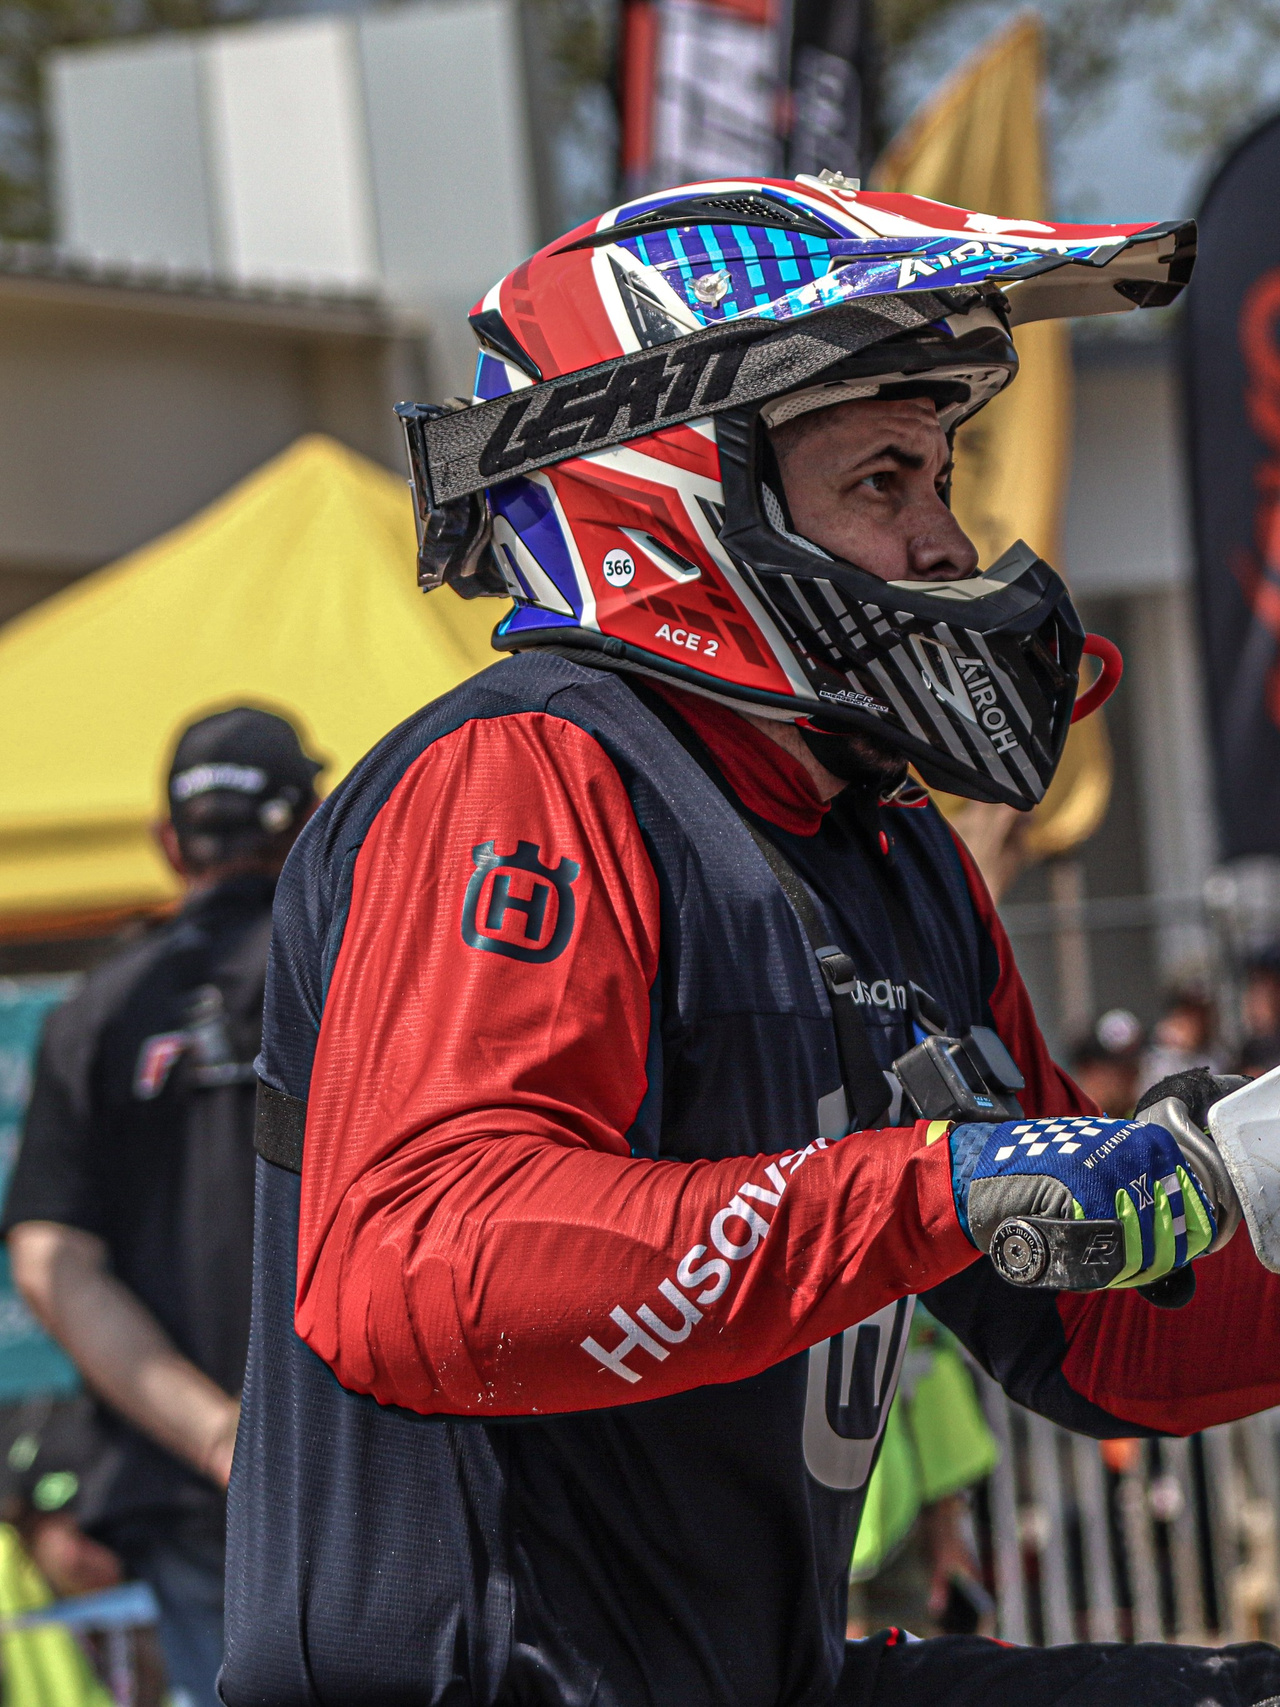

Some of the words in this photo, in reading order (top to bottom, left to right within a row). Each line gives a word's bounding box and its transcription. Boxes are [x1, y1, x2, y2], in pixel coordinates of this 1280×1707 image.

[605, 559, 632, 576] 366
[655, 624, 701, 651] ACE
[703, 640, 719, 657] 2
[867, 703, 888, 712] ONLY
[956, 657, 1018, 754] AIROH
[1096, 1127, 1132, 1159] CHERISH
